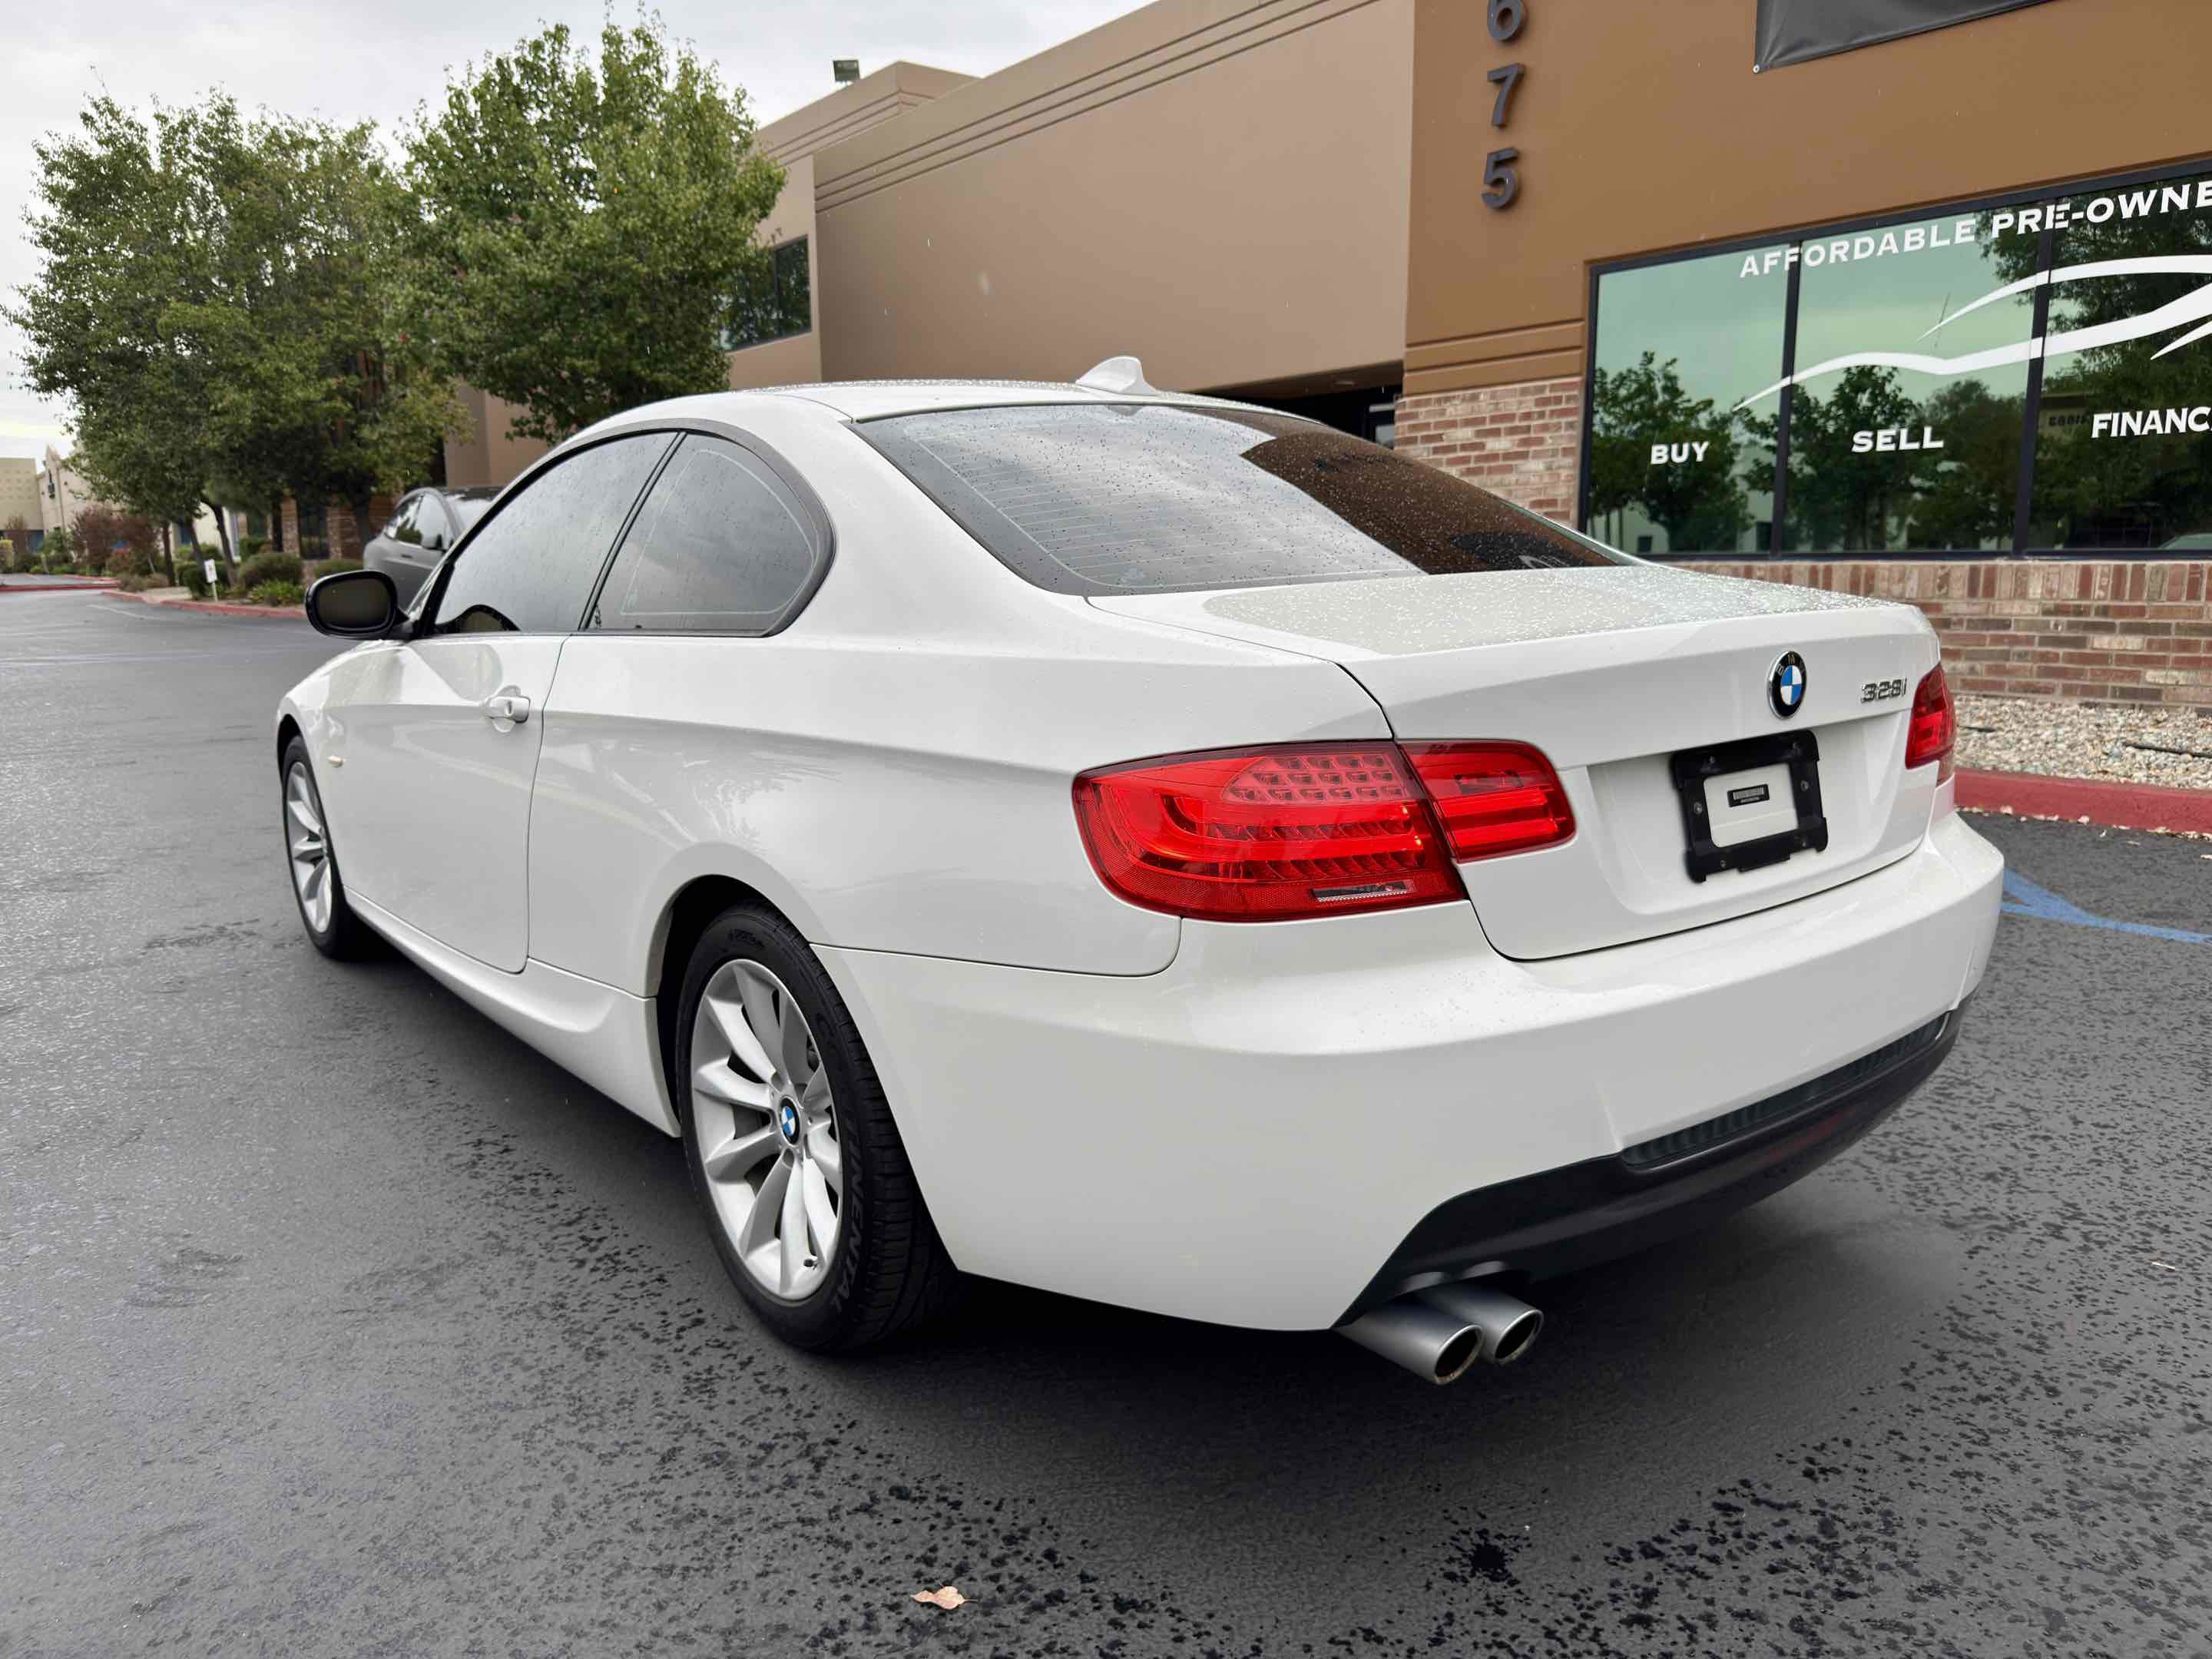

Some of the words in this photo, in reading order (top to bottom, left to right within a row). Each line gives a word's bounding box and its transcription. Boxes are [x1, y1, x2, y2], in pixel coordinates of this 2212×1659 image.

[1739, 217, 1976, 279] AFFORDABLE
[1990, 180, 2212, 239] PRE-OWNE
[2091, 406, 2212, 439] FINANC
[1852, 426, 1945, 453] SELL
[1651, 442, 1710, 465] BUY
[1861, 677, 1907, 704] 328i
